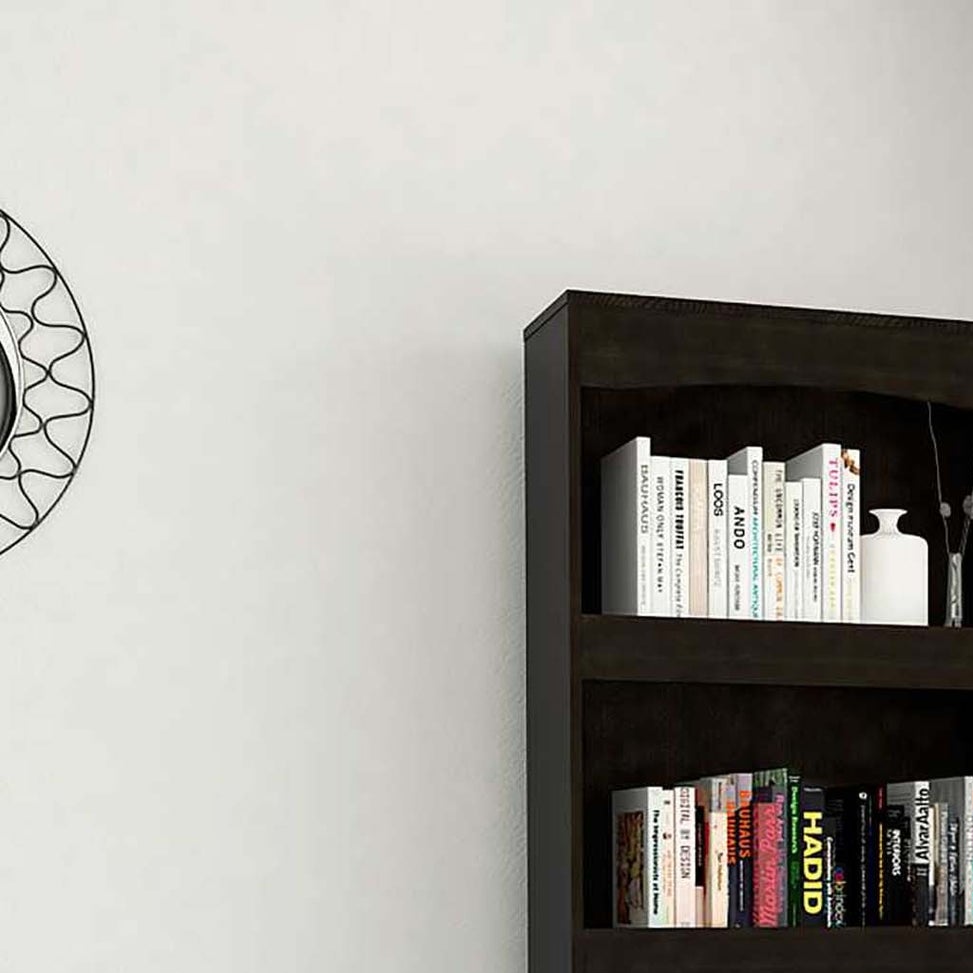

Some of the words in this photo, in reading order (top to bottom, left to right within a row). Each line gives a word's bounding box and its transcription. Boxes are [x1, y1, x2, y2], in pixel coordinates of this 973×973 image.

[641, 464, 649, 534] BAUHAUS
[656, 476, 665, 512] WOMAN
[713, 483, 724, 517] LOOS
[829, 458, 839, 518] TULIPS
[846, 483, 855, 513] Design
[734, 506, 745, 550] ANDO
[791, 786, 799, 815] Design
[739, 790, 752, 859] BAUHAUS
[680, 845, 691, 880] DESIGN
[803, 811, 823, 915] HADID
